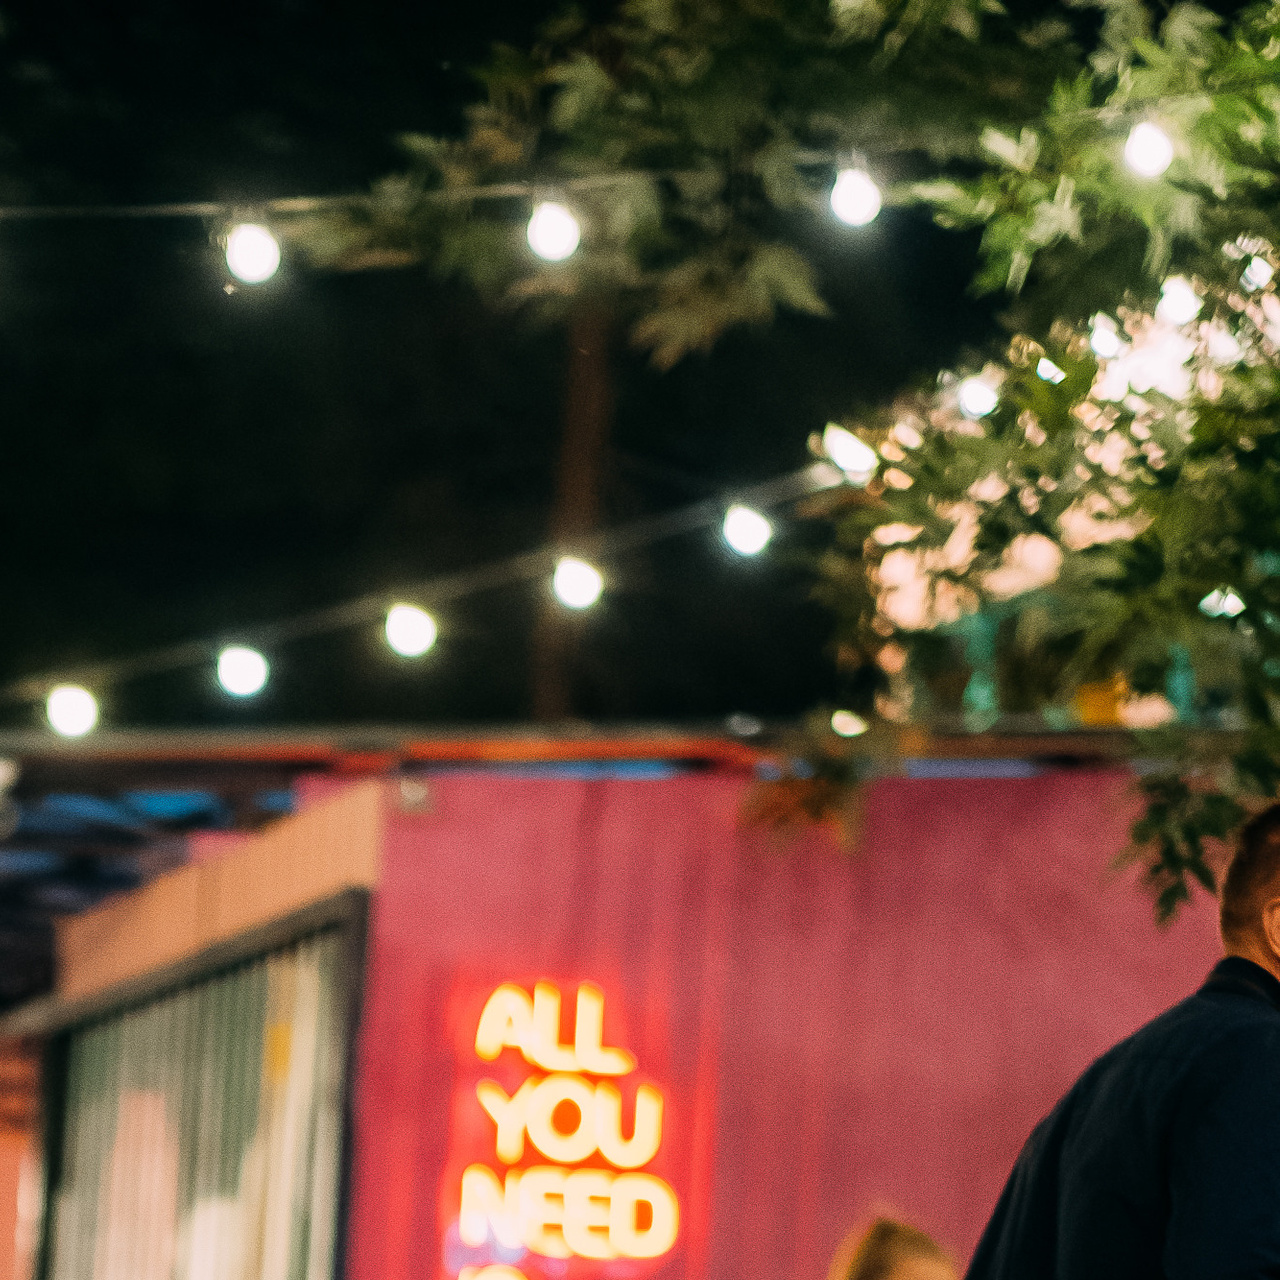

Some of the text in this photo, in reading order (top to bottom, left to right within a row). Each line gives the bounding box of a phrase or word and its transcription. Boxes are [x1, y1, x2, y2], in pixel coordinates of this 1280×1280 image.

[475, 980, 637, 1075] ALL
[476, 1073, 664, 1169] YOU
[459, 1163, 680, 1260] NEED
